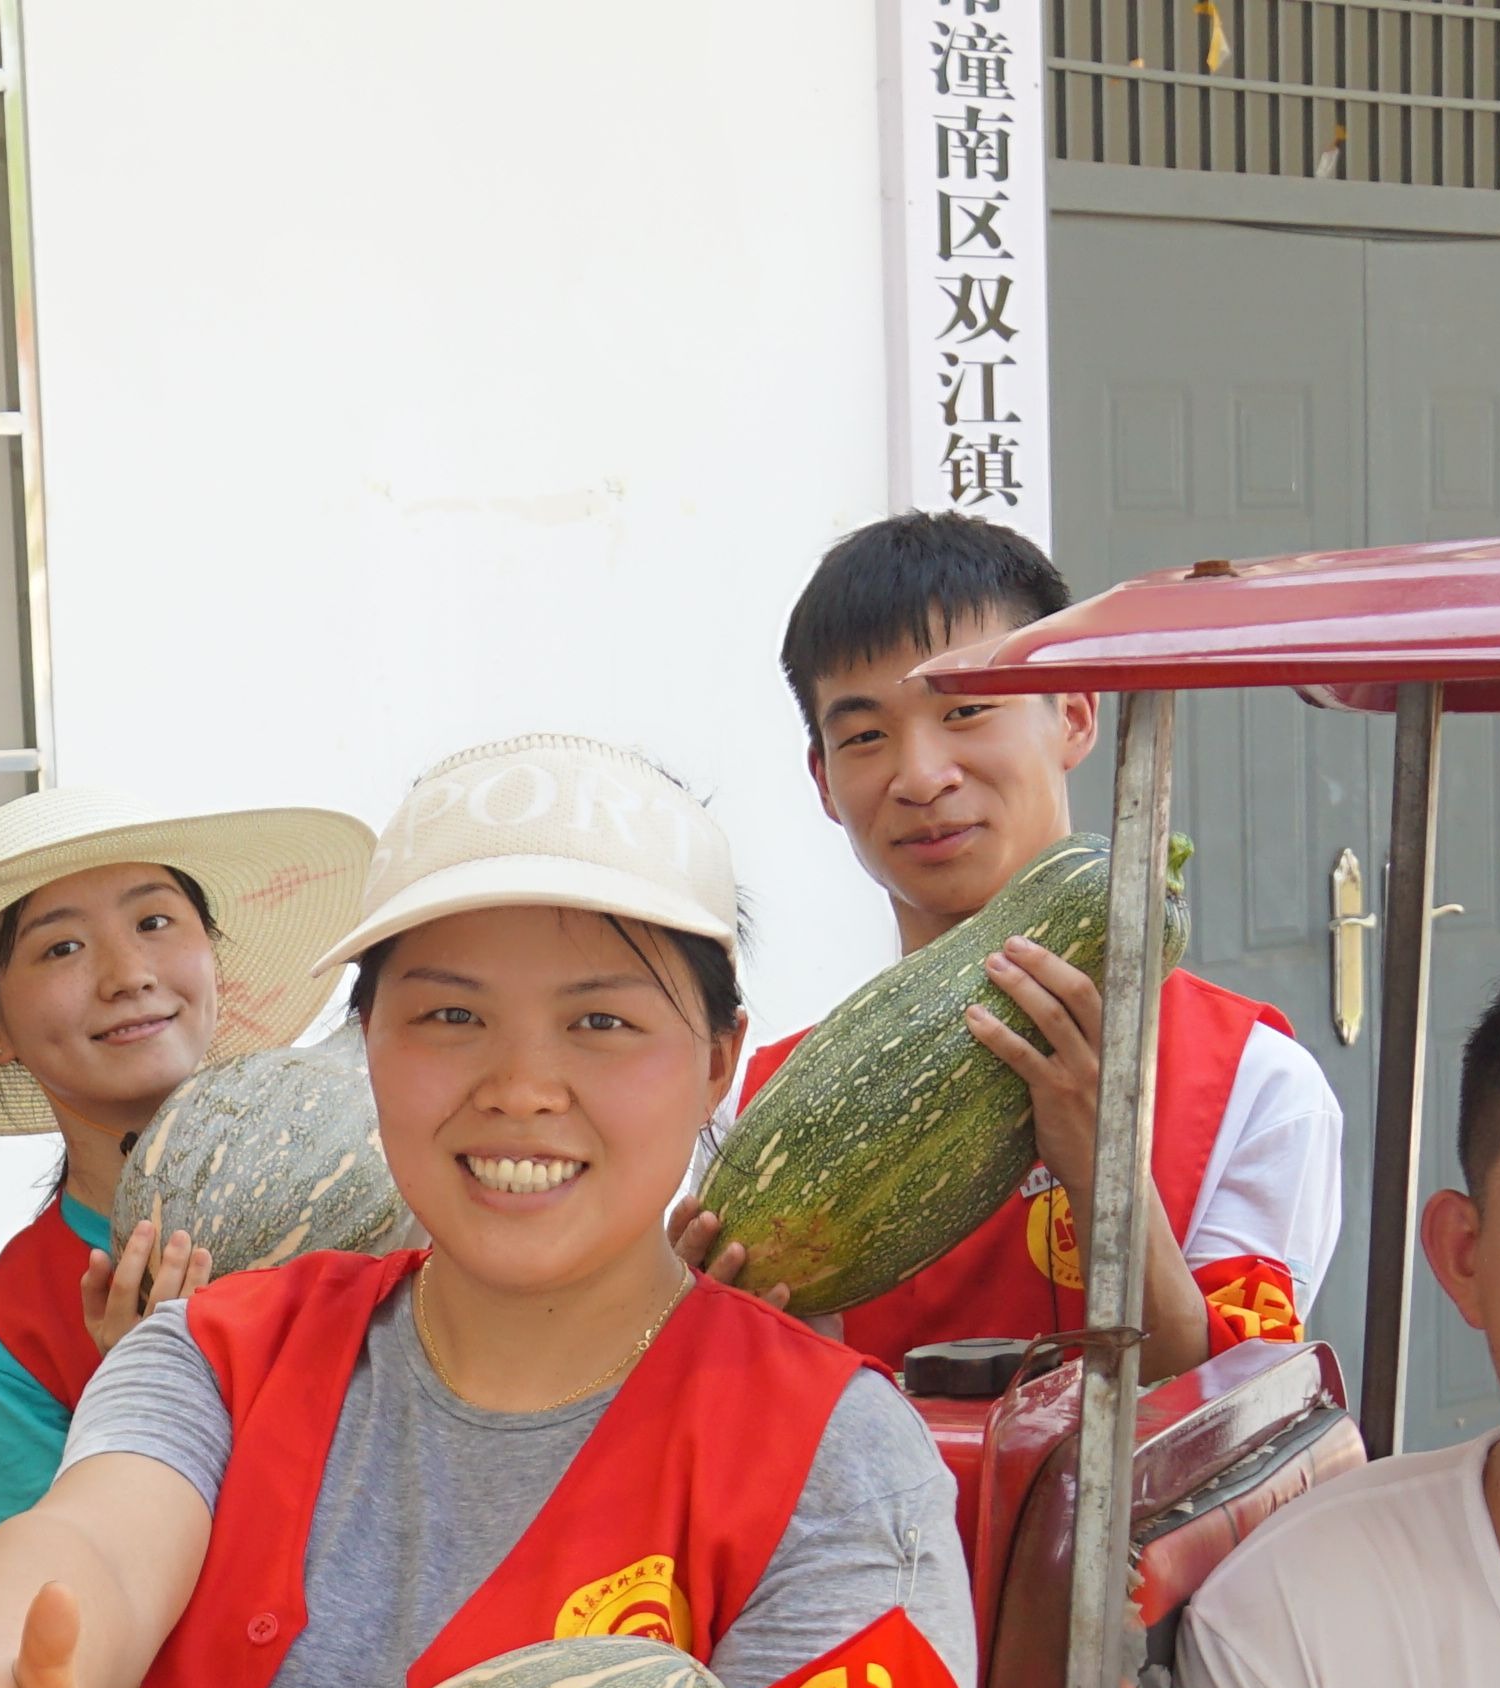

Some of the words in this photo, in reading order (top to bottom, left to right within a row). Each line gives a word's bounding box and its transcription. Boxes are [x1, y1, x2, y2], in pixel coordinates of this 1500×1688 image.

[929, 0, 1023, 507] 潼南区双江镇
